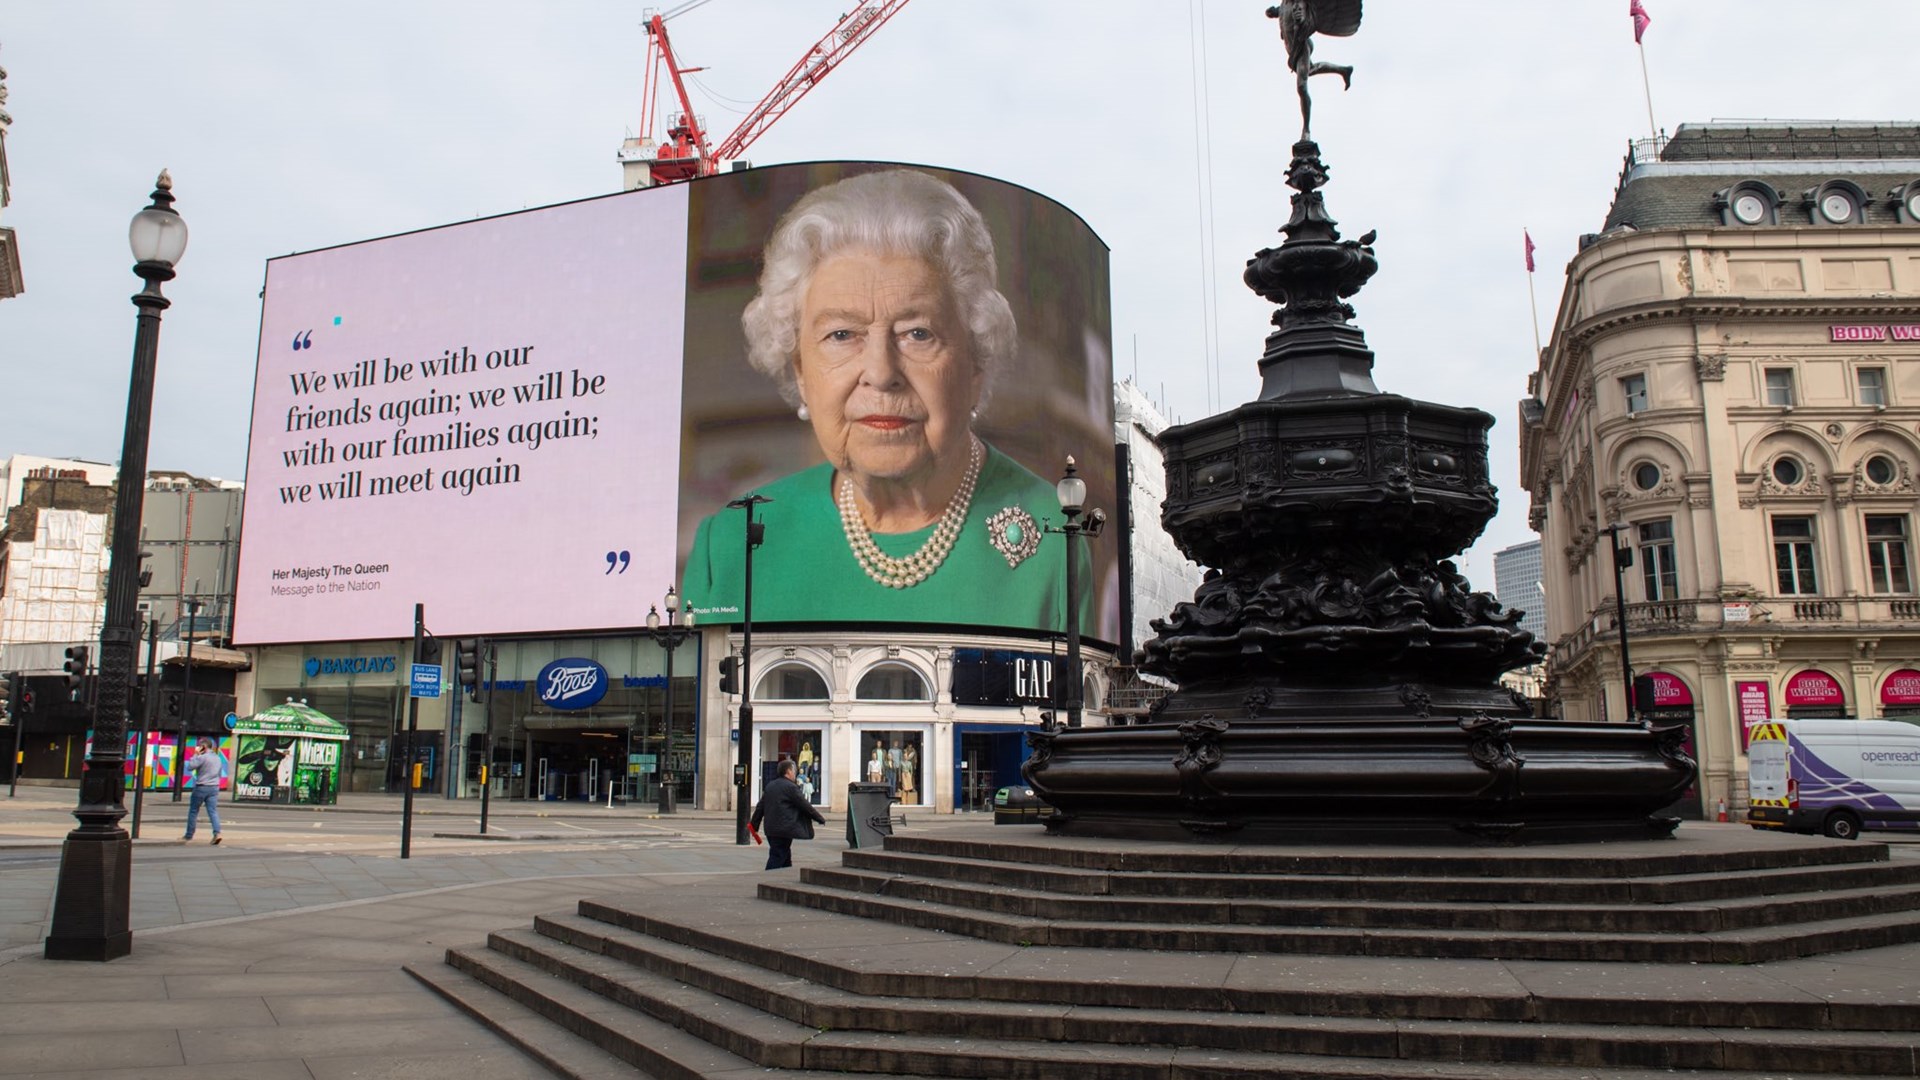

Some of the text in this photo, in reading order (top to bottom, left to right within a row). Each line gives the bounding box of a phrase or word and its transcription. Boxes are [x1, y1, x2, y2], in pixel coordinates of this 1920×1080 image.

[1830, 325, 1887, 341] BODY
[289, 346, 535, 396] We will be with our
[285, 368, 606, 433] friends again; we will be
[283, 411, 598, 468] with our families again;
[279, 456, 521, 505] we will meet again
[272, 563, 389, 581] Her Majesty The Queen
[271, 580, 381, 598] Message to the Nation
[720, 605, 739, 613] Media
[322, 656, 396, 673] BARCLAYS
[542, 666, 598, 700] Boots
[1015, 658, 1052, 699] GAP
[1798, 679, 1828, 688] BODY
[1790, 688, 1838, 697] WORLDS
